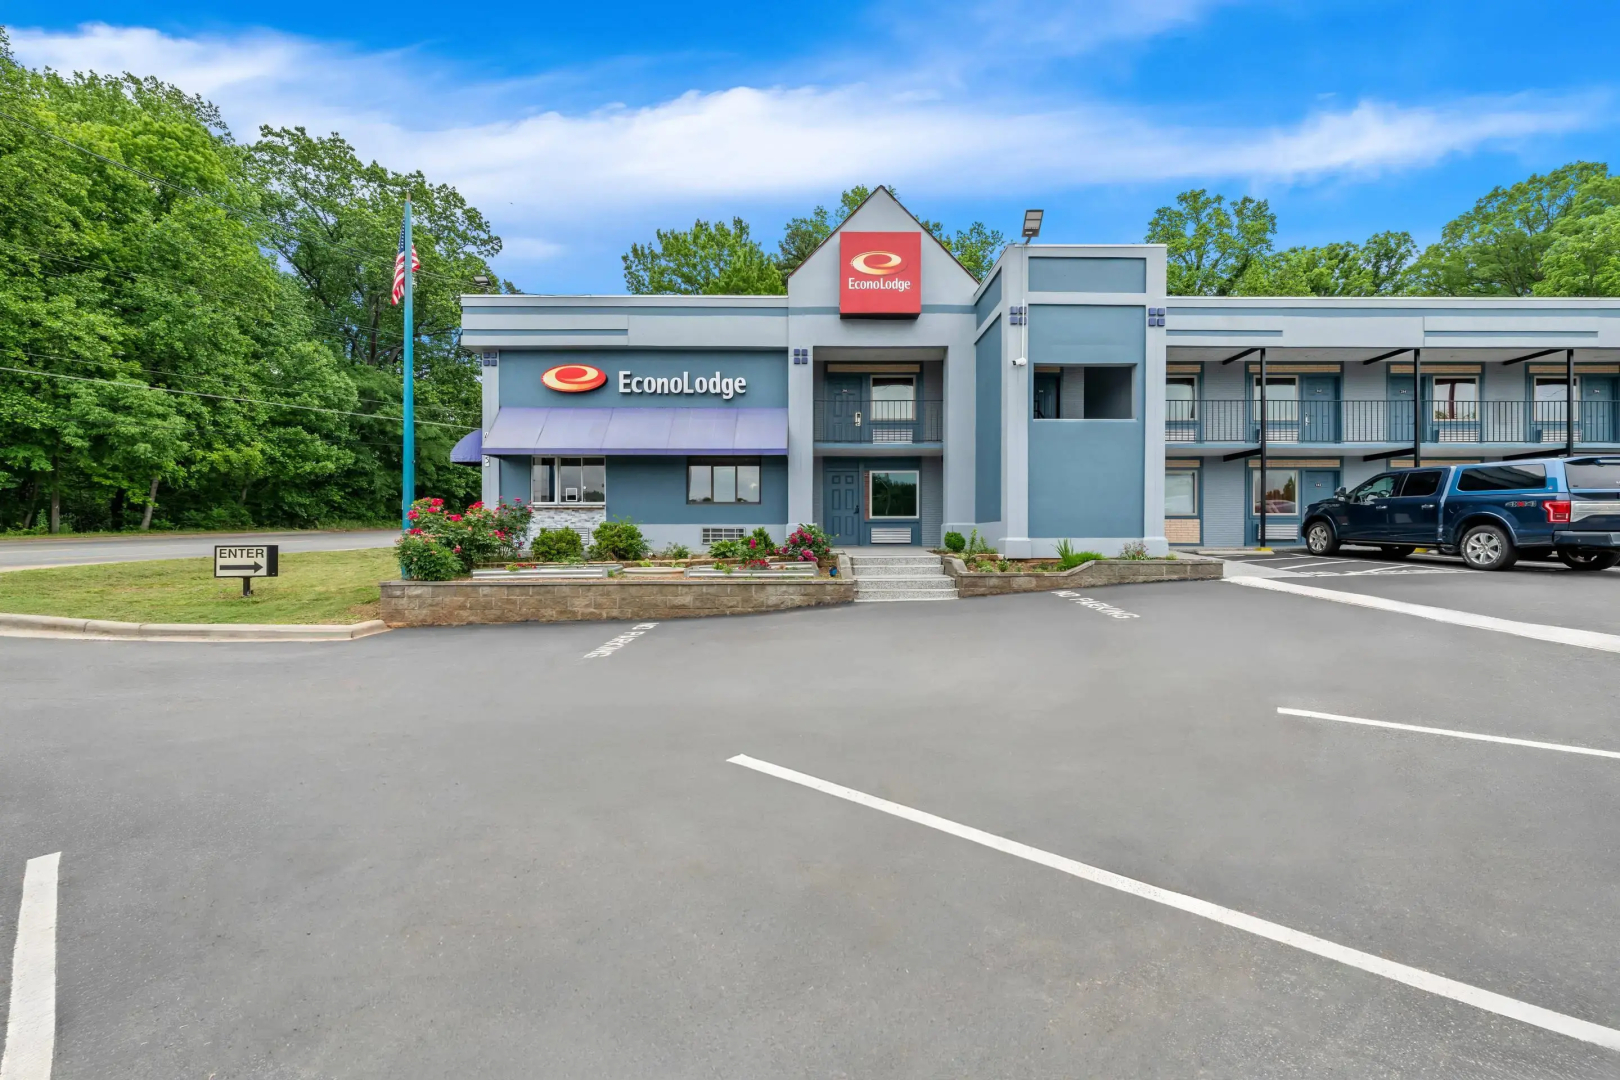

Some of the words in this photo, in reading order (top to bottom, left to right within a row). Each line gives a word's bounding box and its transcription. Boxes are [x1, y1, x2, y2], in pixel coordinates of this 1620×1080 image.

[848, 277, 911, 292] EconoLodge
[618, 370, 747, 400] EconoLodge
[219, 548, 264, 558] ENTER
[1068, 597, 1141, 619] PARKING
